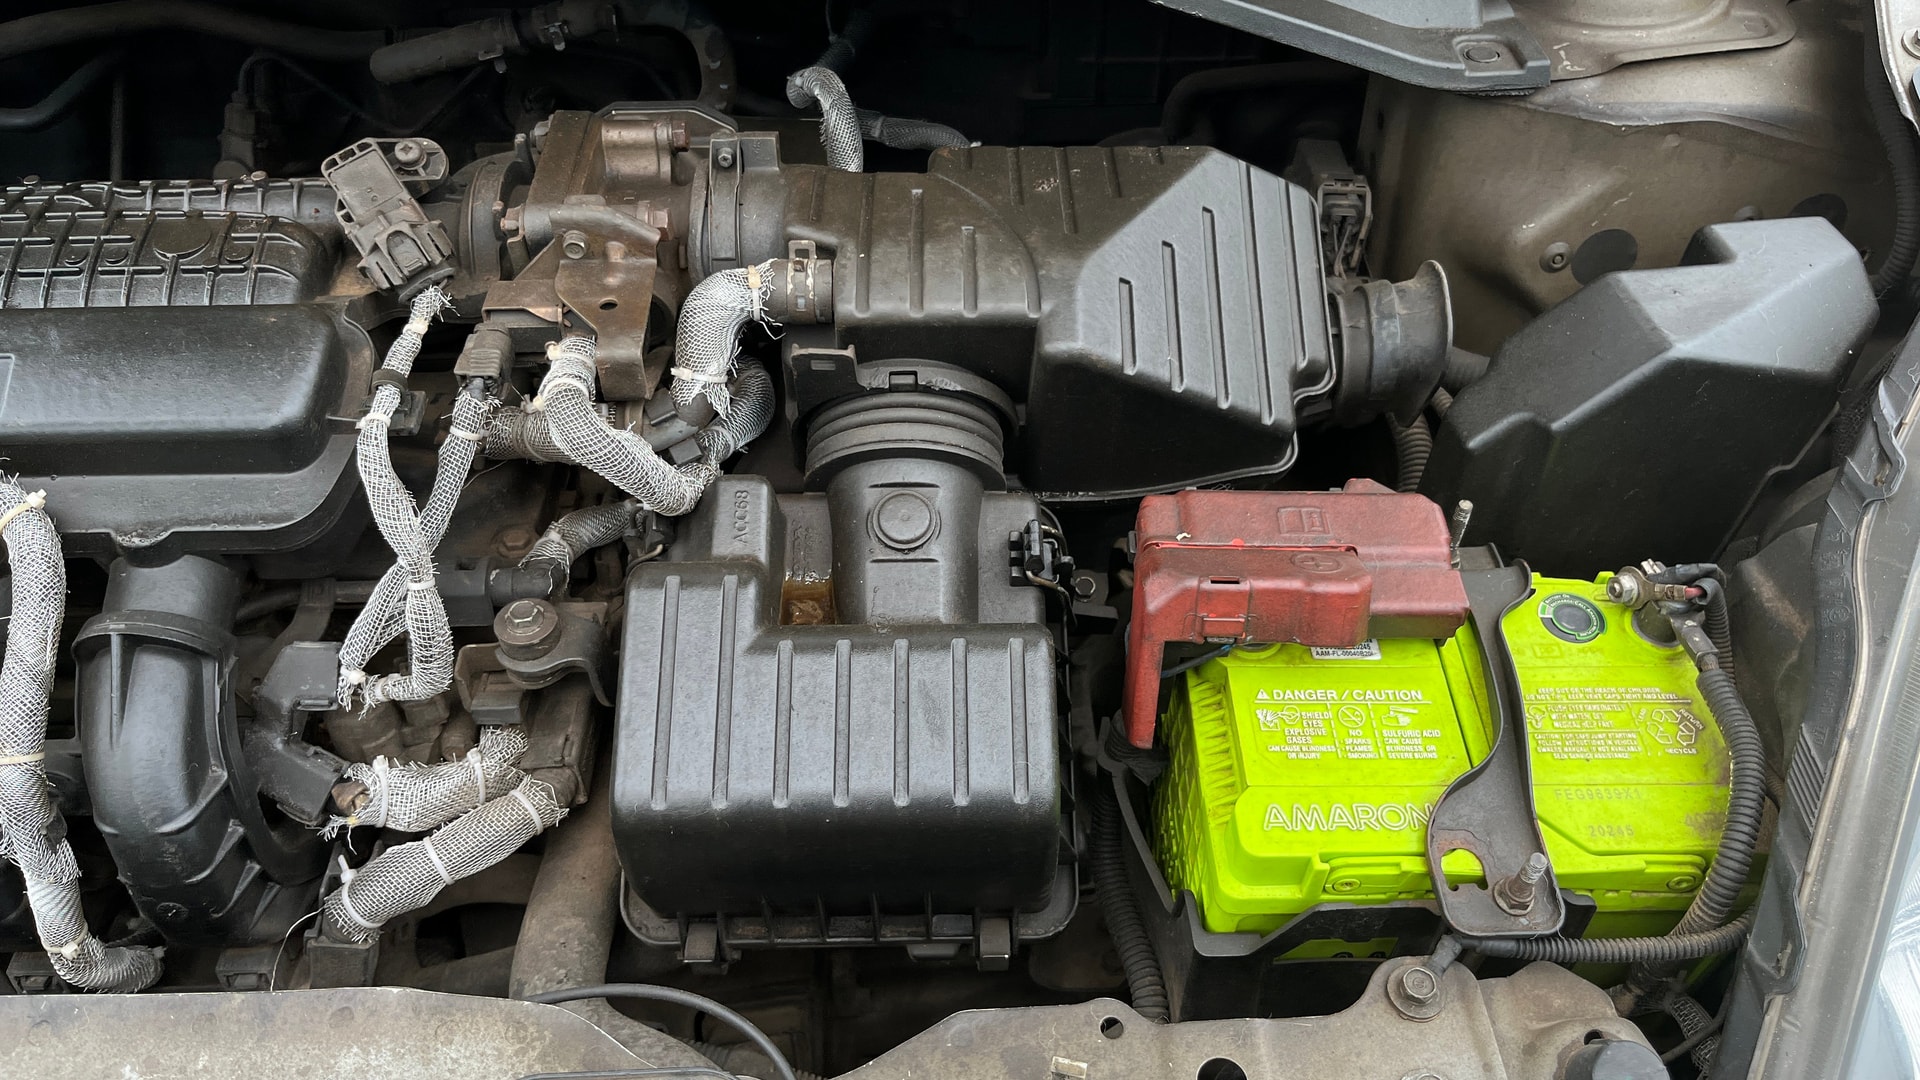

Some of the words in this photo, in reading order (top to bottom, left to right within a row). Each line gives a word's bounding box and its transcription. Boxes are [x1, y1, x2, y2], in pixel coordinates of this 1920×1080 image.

[1273, 690, 1338, 700] DANGER
[1342, 690, 1350, 700] /
[1353, 690, 1422, 700] CAUTION
[1264, 803, 1432, 831] AMARON
